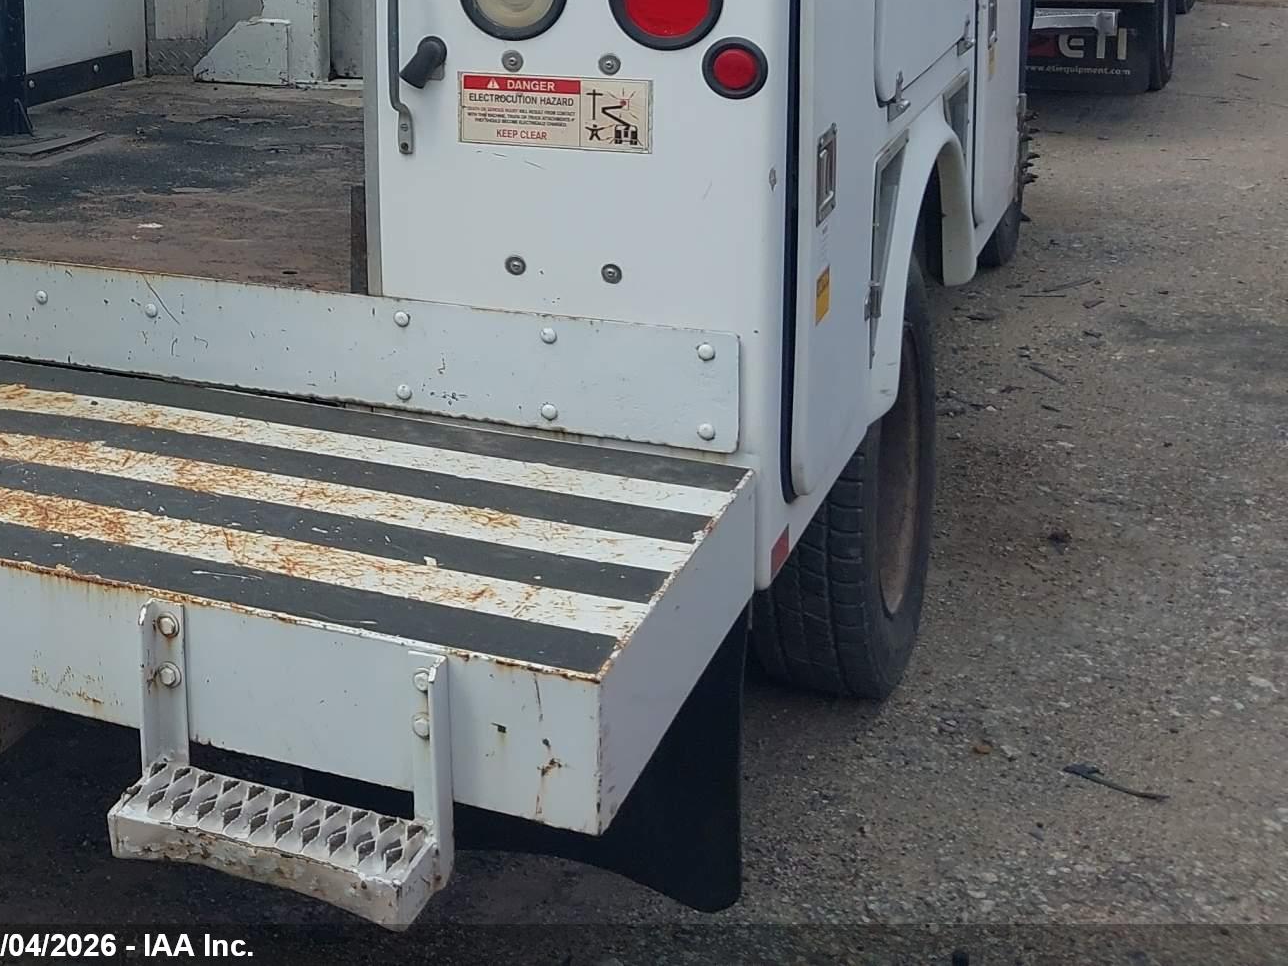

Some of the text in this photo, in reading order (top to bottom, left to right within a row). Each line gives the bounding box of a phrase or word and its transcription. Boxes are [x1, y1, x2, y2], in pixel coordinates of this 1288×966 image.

[506, 79, 556, 91] DANGER
[469, 92, 574, 107] ELECTROCUTION HAZARD
[497, 129, 547, 140] KEEP CLEAR
